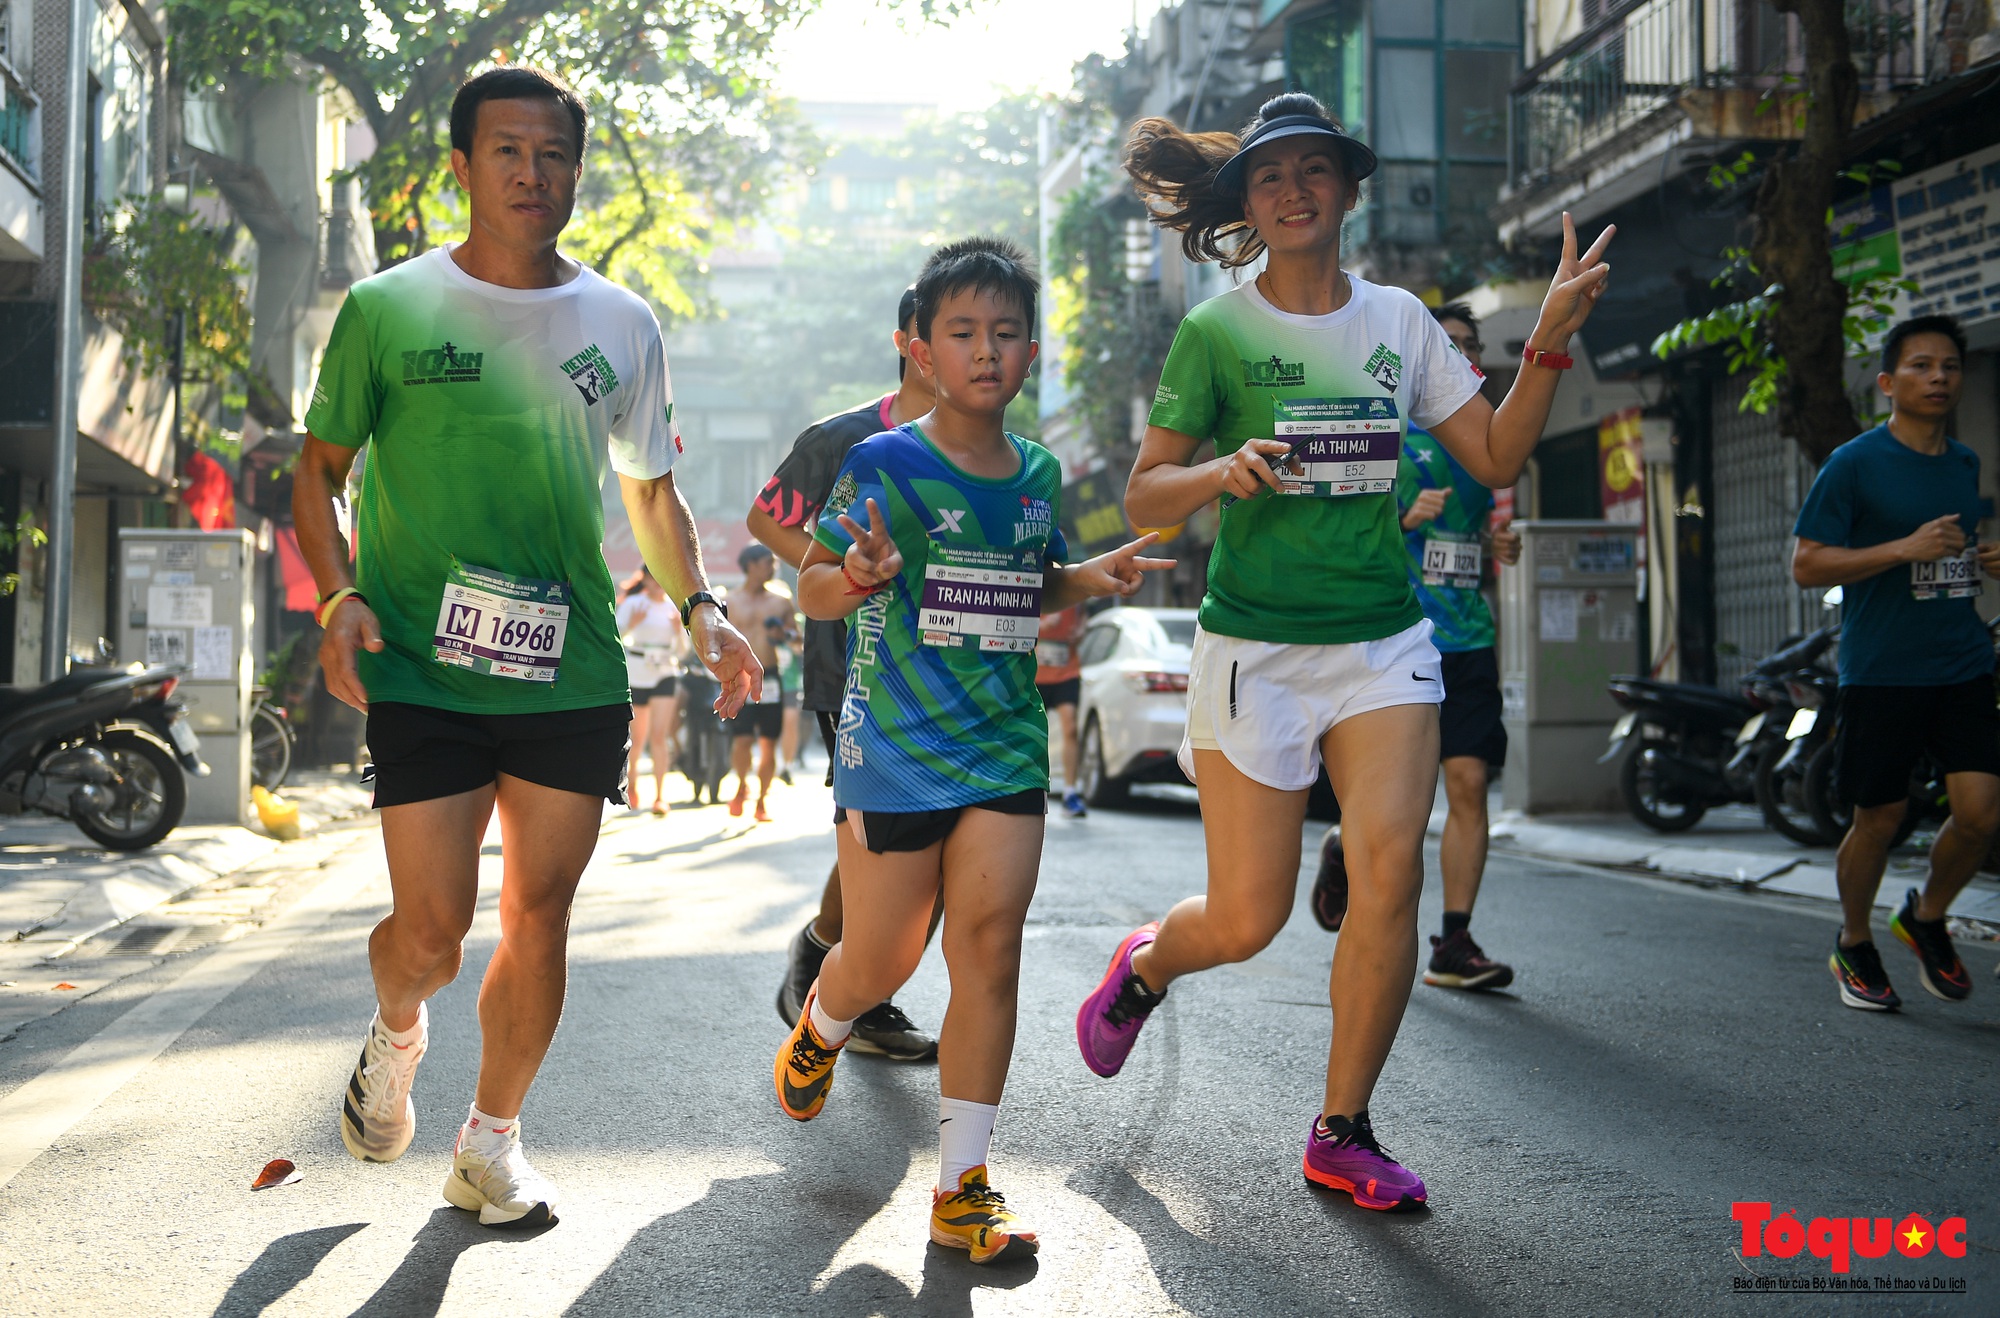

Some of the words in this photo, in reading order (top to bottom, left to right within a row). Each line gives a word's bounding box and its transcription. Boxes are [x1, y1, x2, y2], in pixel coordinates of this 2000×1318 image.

[560, 343, 601, 375] VIETNAM
[1362, 342, 1387, 374] VIETNAM
[1309, 440, 1326, 455] HA
[1329, 440, 1347, 454] THI
[1349, 439, 1369, 454] MAI
[1281, 466, 1290, 476] 10
[1345, 463, 1366, 477] E52
[1918, 561, 1936, 582] M
[937, 586, 972, 605] TRAN
[974, 590, 991, 607] HA
[993, 591, 1020, 609] MINH
[1020, 593, 1034, 609] AN
[928, 613, 938, 625] 10
[939, 615, 955, 627] KM
[995, 618, 1016, 632] E03
[448, 604, 479, 638] M
[490, 616, 556, 652] 16968
[444, 639, 452, 647] 10
[452, 640, 464, 650] KM
[503, 653, 517, 661] TRAN
